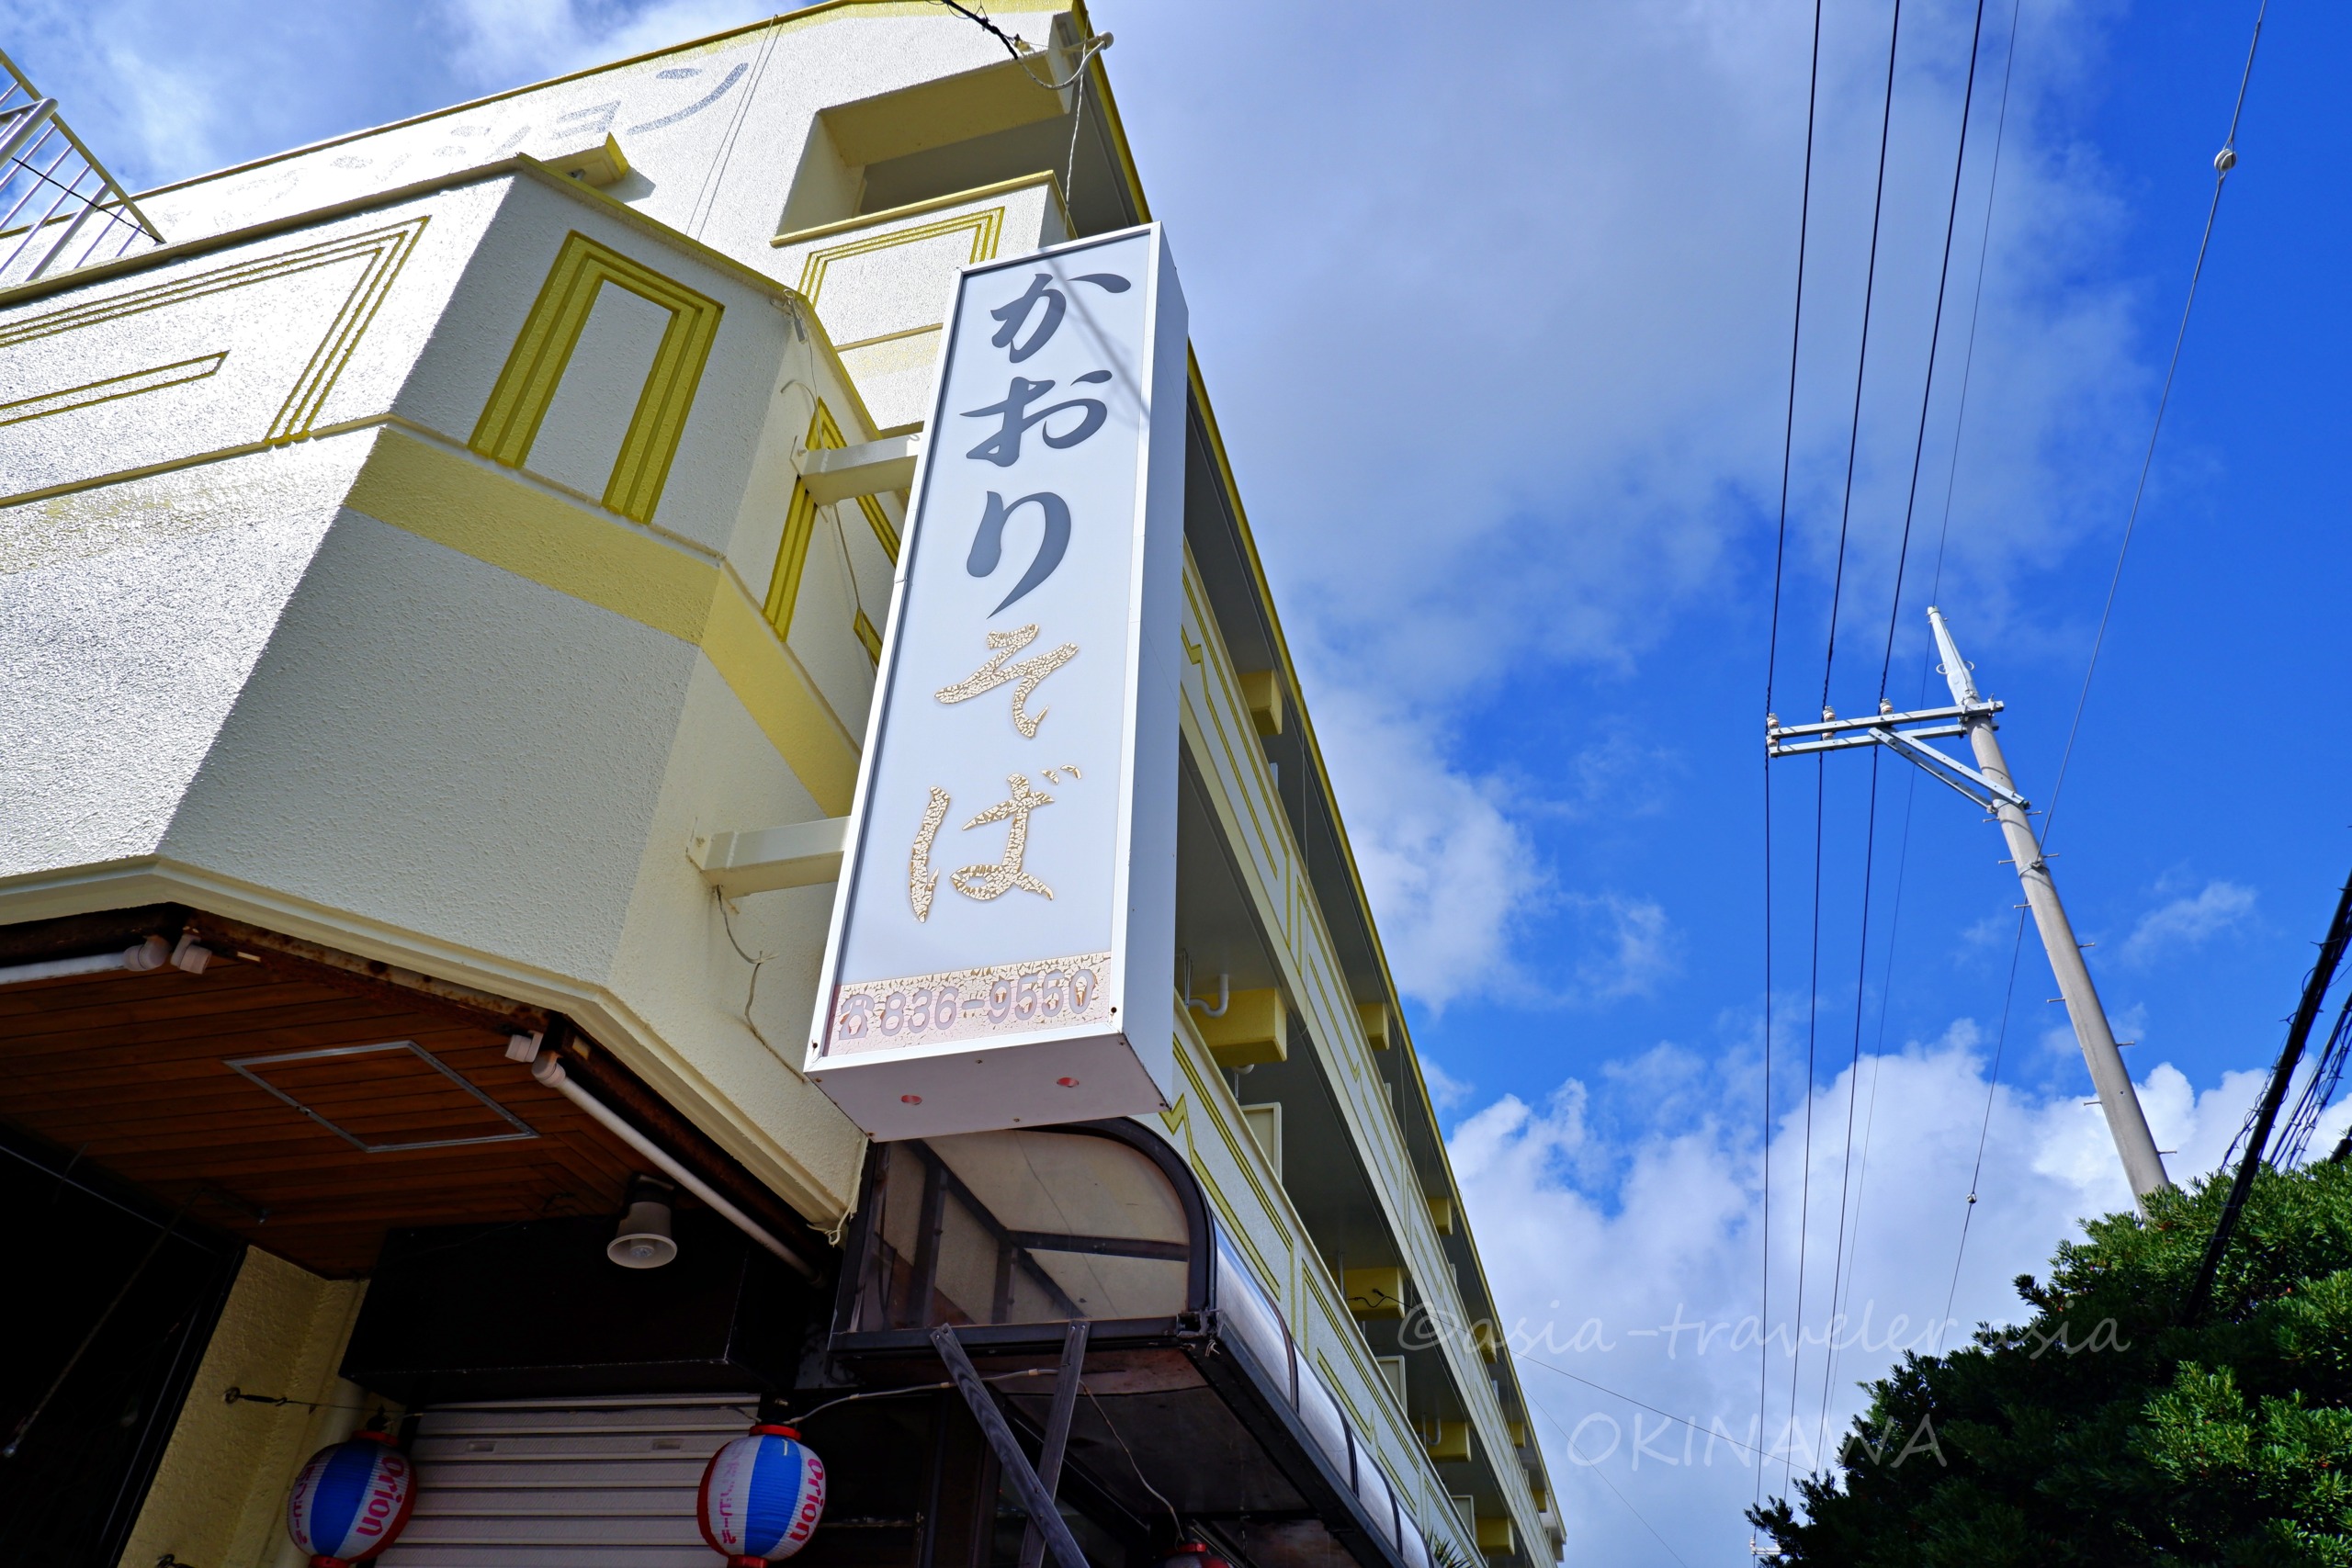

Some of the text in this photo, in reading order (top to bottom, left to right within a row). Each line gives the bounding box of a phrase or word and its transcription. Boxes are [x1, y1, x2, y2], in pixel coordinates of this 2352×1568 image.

[910, 273, 1131, 923] かおりそば
[356, 1456, 404, 1536] Orion
[789, 1459, 825, 1541] Orion
